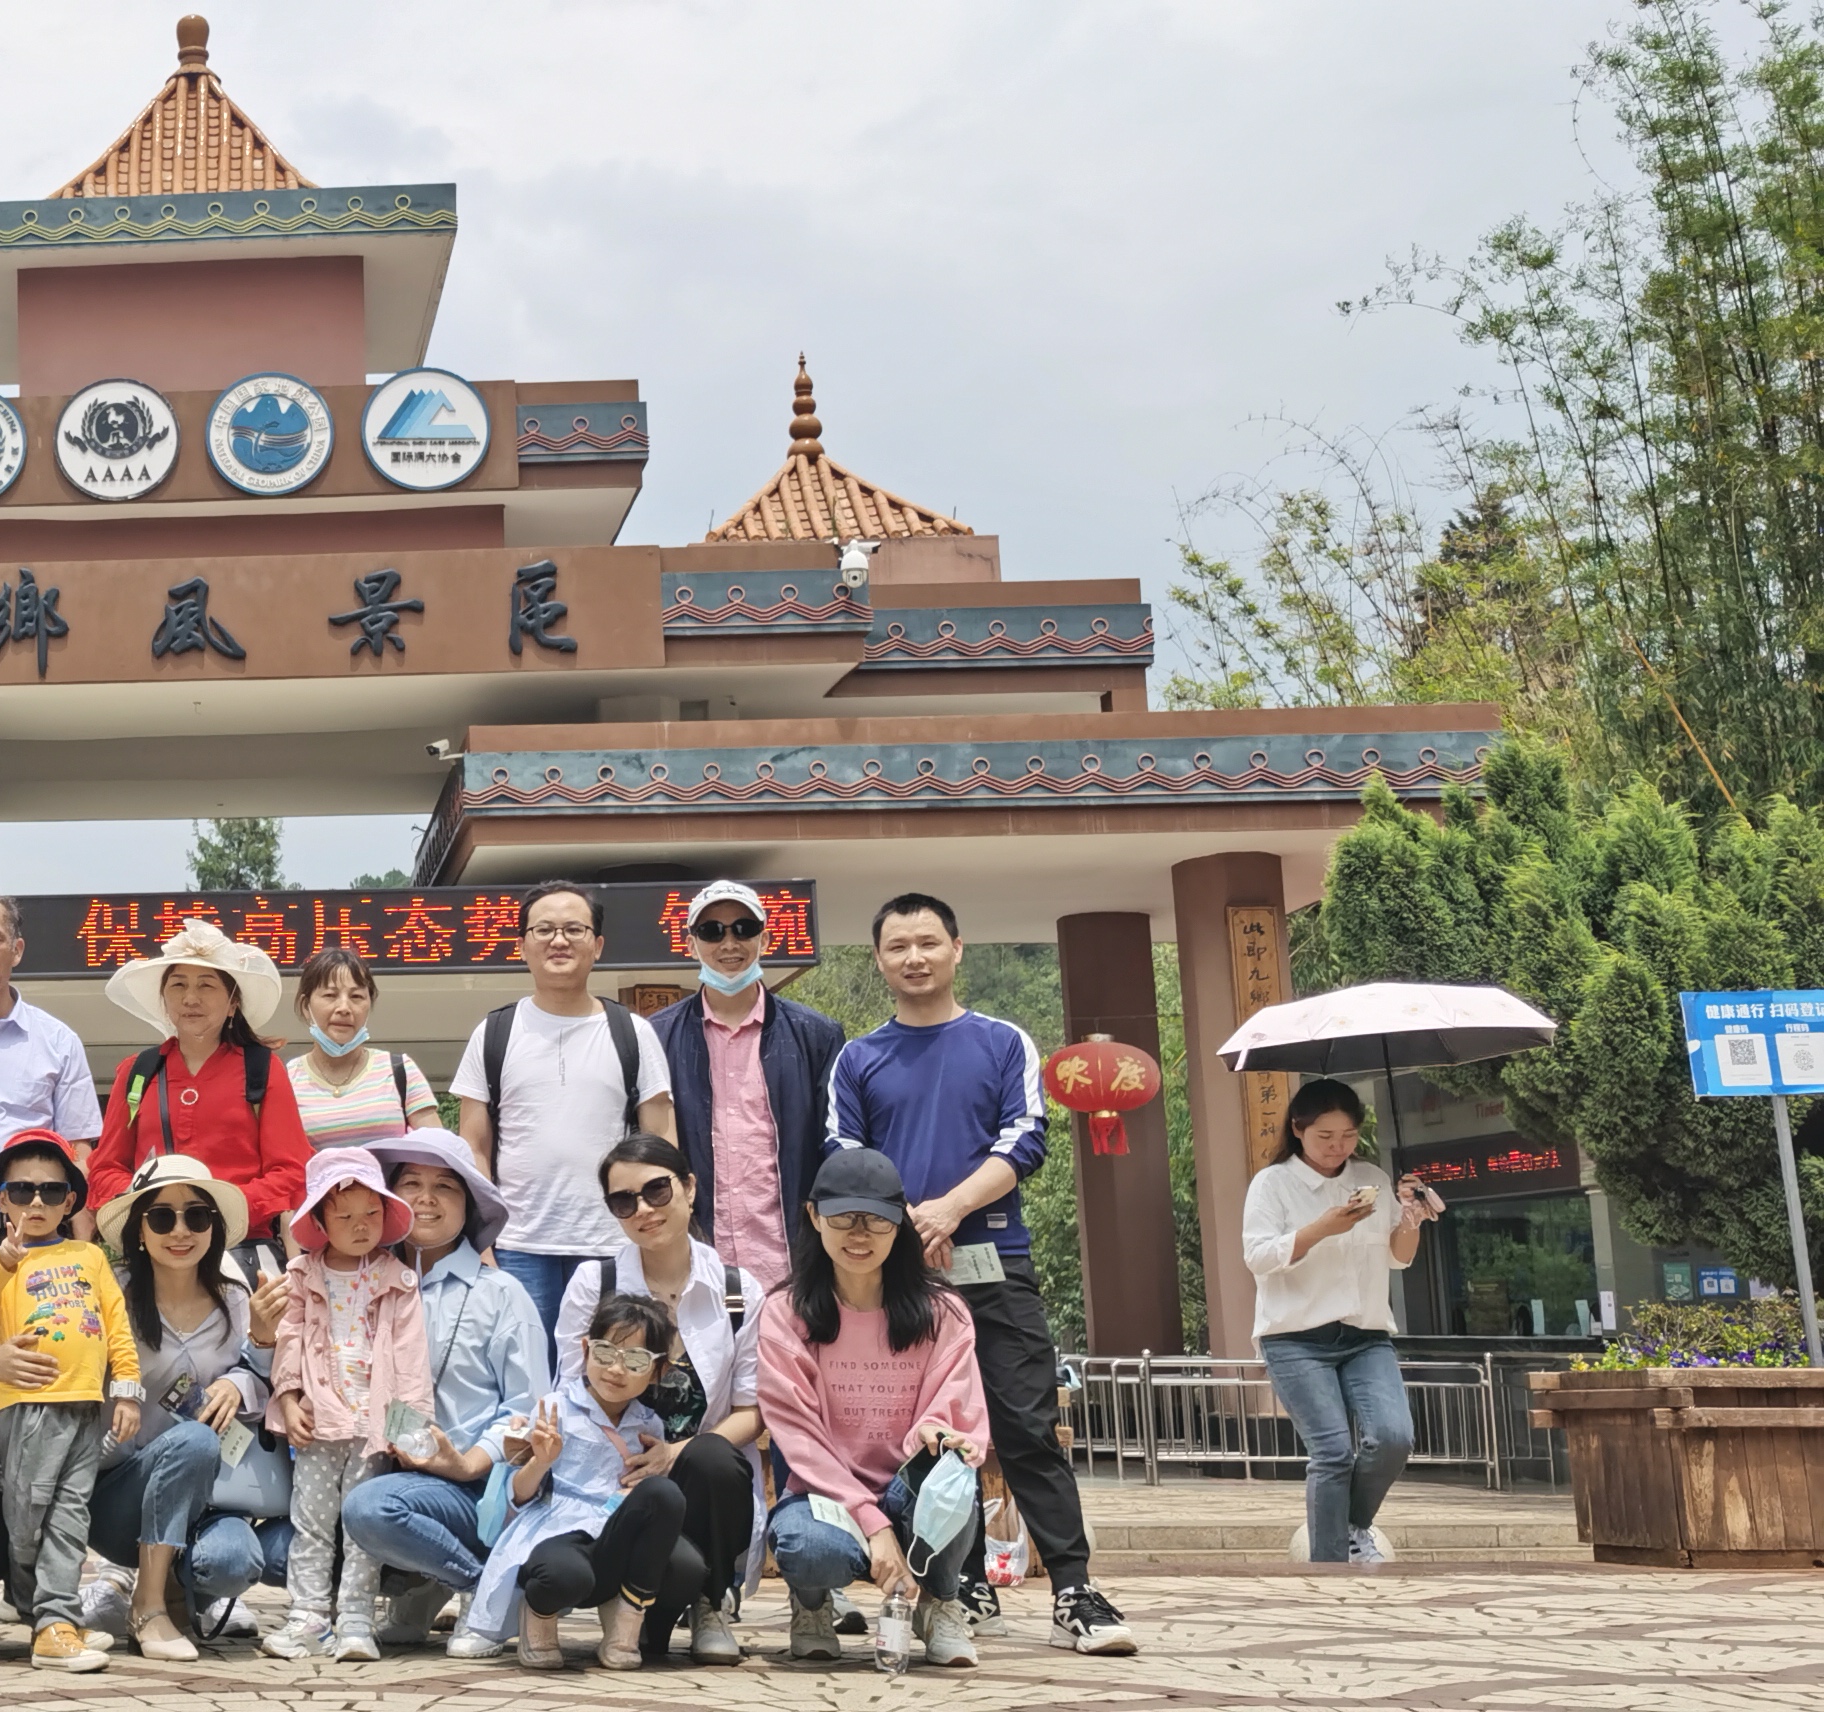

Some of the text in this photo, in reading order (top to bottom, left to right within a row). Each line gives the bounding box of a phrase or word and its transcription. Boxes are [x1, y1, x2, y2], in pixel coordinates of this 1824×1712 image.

[83, 463, 153, 483] AAAA
[1705, 1003, 1766, 1020] 健康通行
[829, 1361, 922, 1371] FIND SOMEONE
[831, 1383, 863, 1393] THAT
[869, 1384, 895, 1393] YOU
[844, 1407, 866, 1416] BUT
[867, 1431, 893, 1441] ARE
